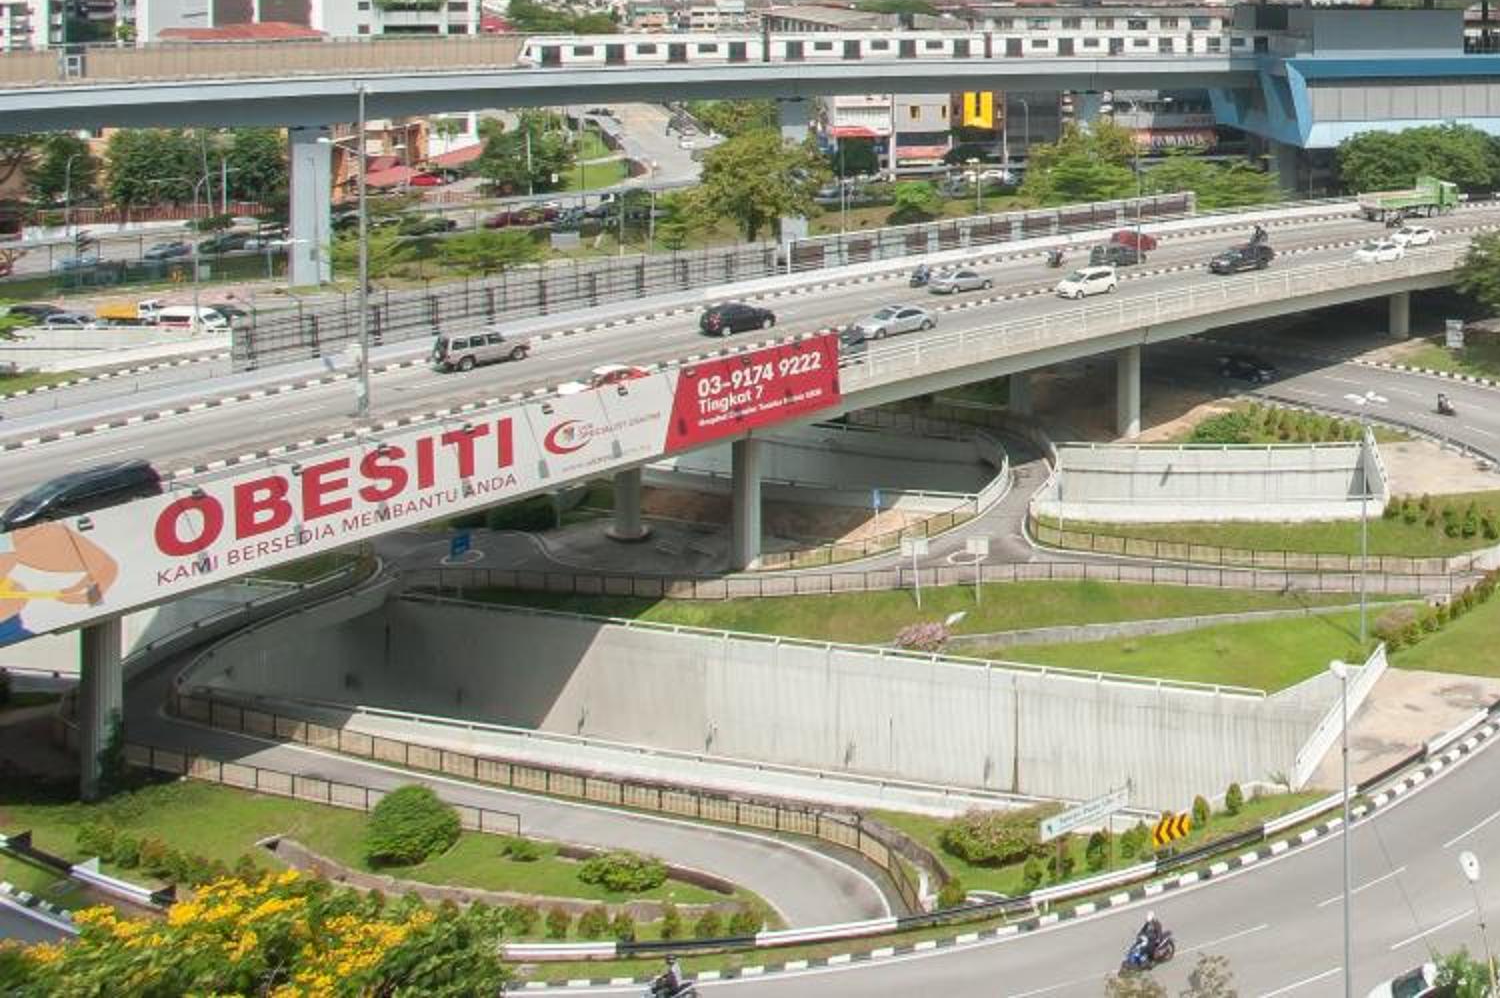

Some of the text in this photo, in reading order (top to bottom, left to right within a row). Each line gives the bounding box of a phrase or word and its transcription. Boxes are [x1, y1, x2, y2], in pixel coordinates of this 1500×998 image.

[697, 351, 822, 397] 03-9174 9222
[698, 390, 752, 414] Tingkat
[755, 385, 764, 401] 7
[154, 417, 513, 556] OBESITI
[157, 473, 517, 586] KAMI BERSEDIA MEMBANTU ANDA
